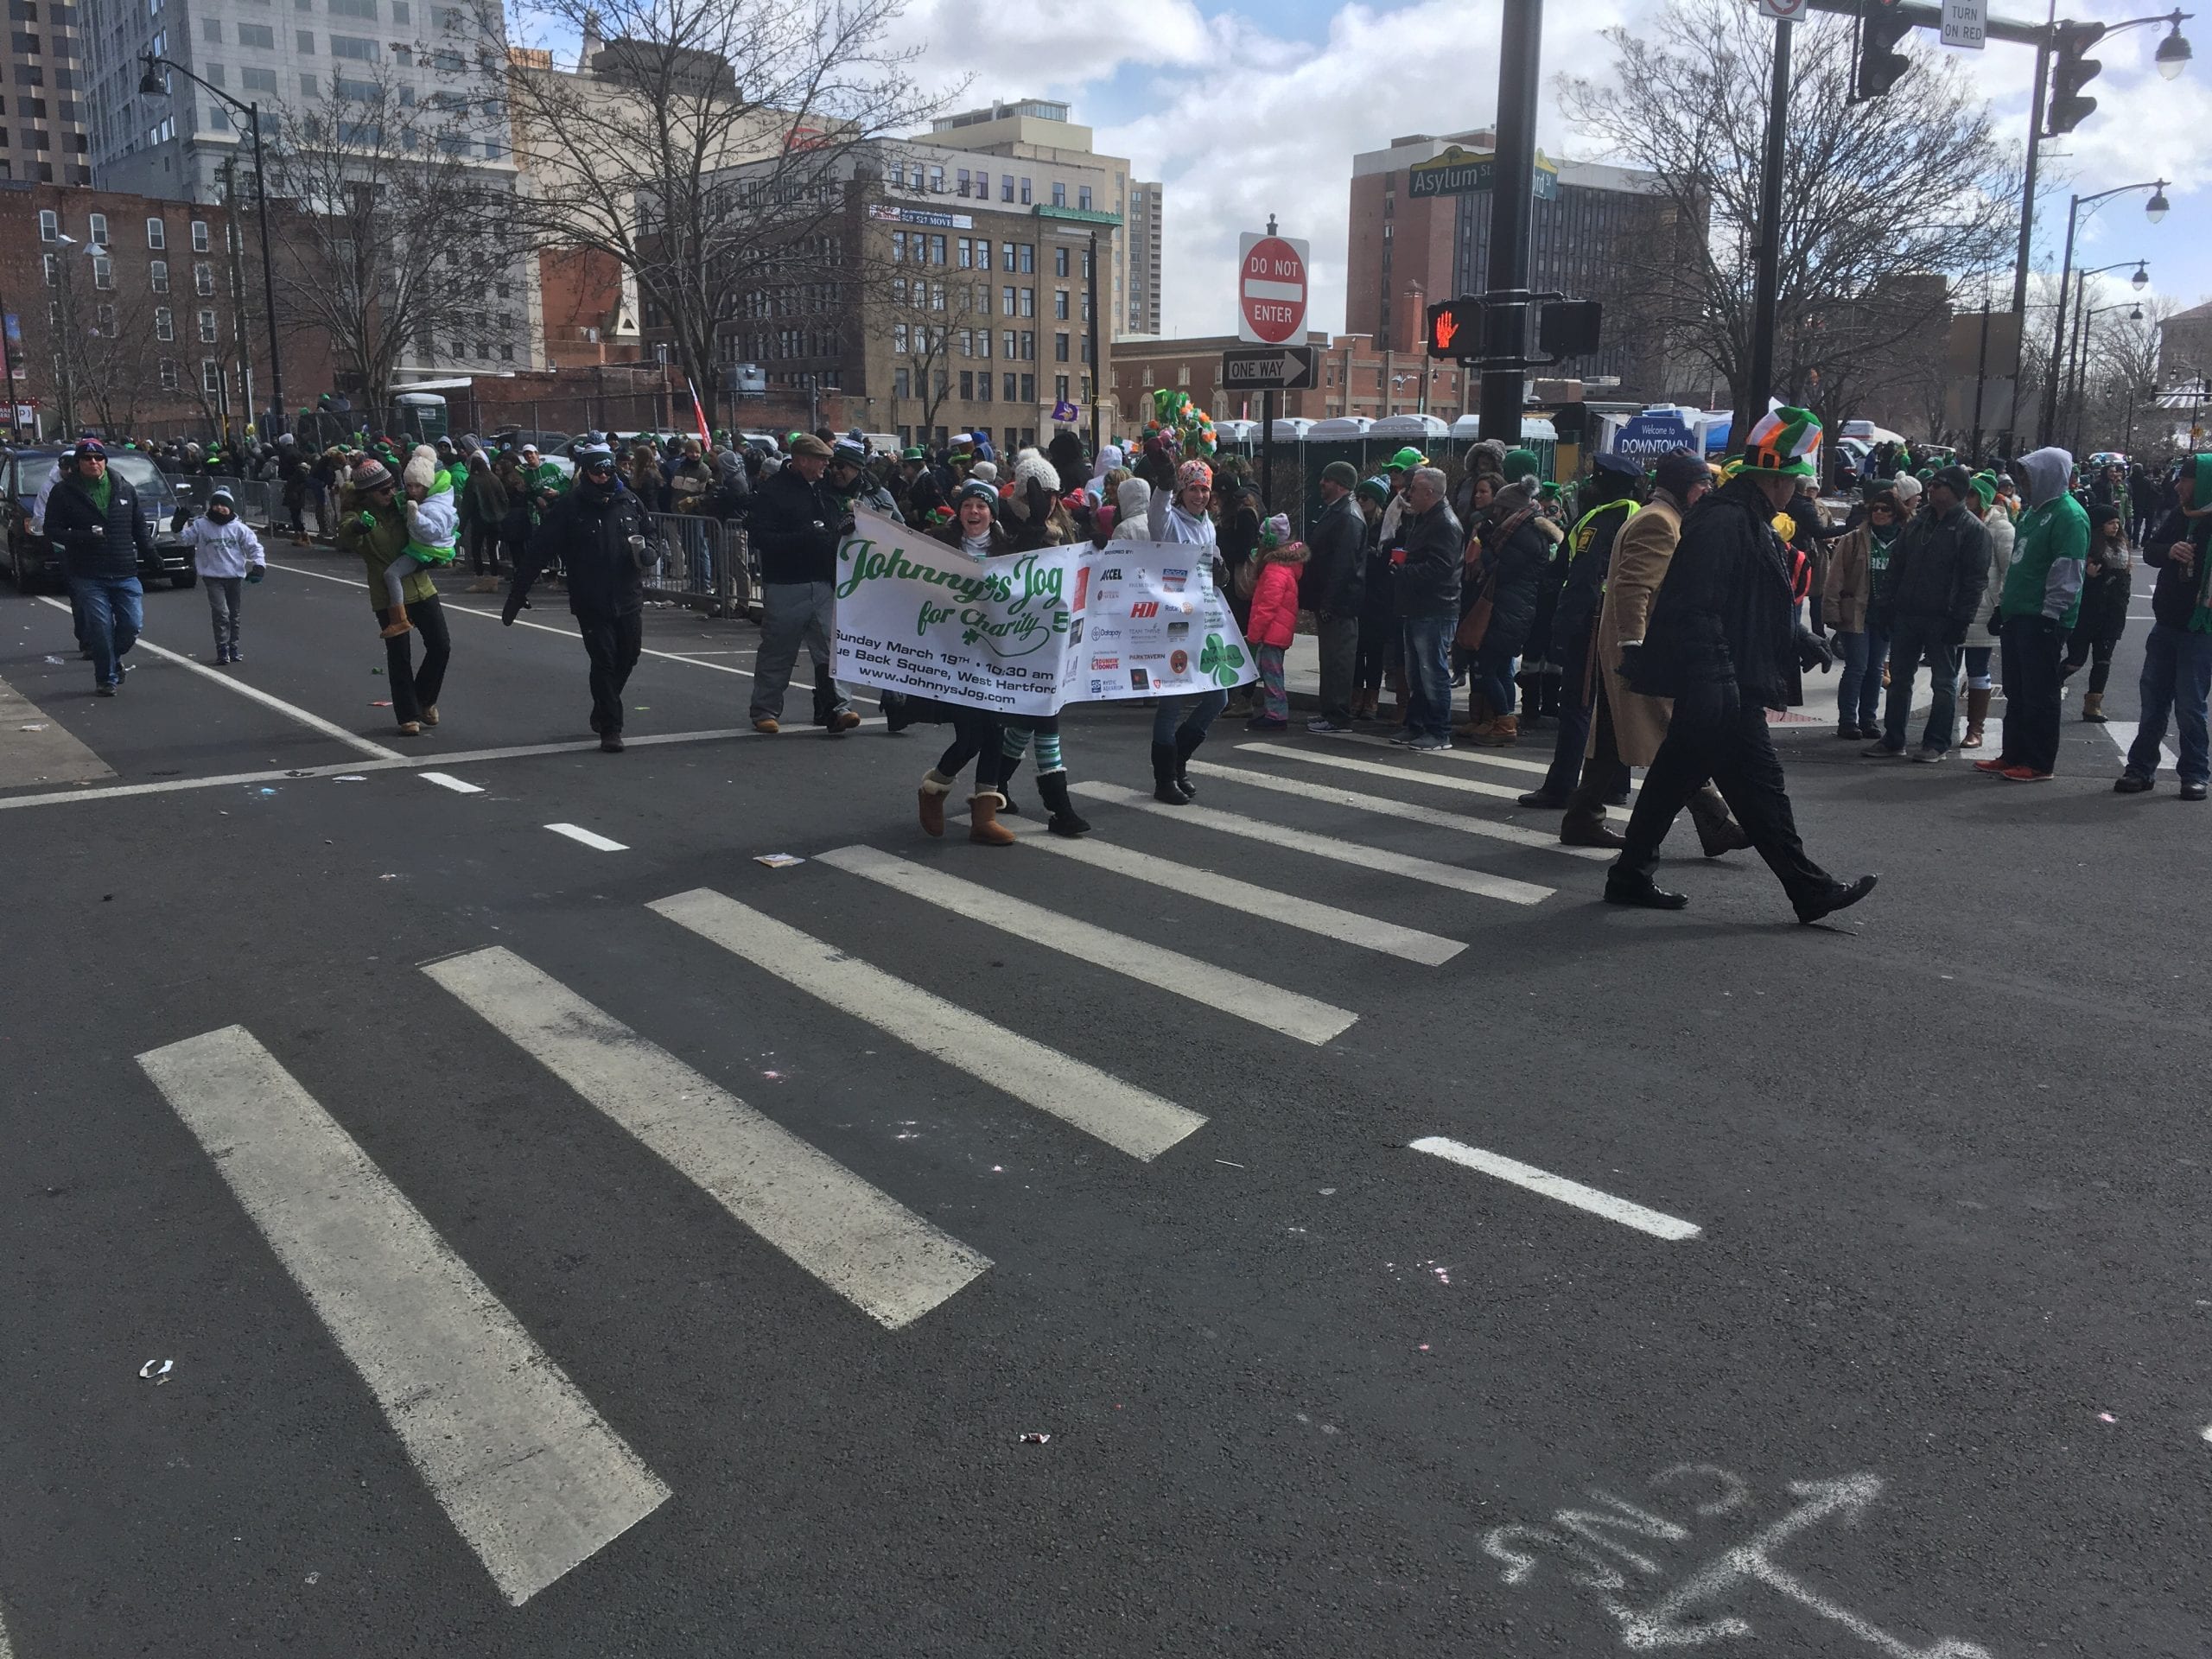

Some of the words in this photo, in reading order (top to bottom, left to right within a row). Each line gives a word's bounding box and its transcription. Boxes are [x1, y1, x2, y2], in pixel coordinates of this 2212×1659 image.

[1952, 6, 1978, 21] TURN
[1945, 24, 1959, 37] ON
[1963, 27, 1982, 40] RED
[1414, 168, 1478, 194] Asylum
[1480, 164, 1491, 176] St
[1532, 175, 1545, 194] ord
[1546, 175, 1551, 188] St
[930, 217, 952, 226] MOVE
[1251, 257, 1268, 274] DO
[1274, 259, 1299, 277] NOT
[1255, 304, 1293, 323] ENTER
[1231, 361, 1255, 378] ONE
[1259, 359, 1285, 378] WAY
[1642, 423, 1668, 435] Welcome
[1669, 426, 1675, 435] to
[1621, 438, 1688, 454] DOWNTOWN
[836, 539, 1012, 604] Johnny's
[1007, 554, 1064, 615] Jog
[1100, 568, 1122, 582] ACCEL
[1165, 604, 1182, 613] Rotary
[918, 600, 955, 636] for
[960, 607, 1040, 641] Charity
[1100, 629, 1122, 639] Datapay
[836, 630, 882, 651] Sunday
[886, 640, 934, 660] March
[985, 662, 1027, 677] 10:30
[1032, 671, 1054, 681] am
[1201, 654, 1239, 664] ANNUAL
[836, 648, 850, 658] ue
[855, 650, 891, 666] Back
[896, 658, 951, 680] Square,
[957, 671, 992, 687] West
[995, 679, 1057, 695] Hartford
[859, 666, 1016, 705] www.JohnnysJog.com
